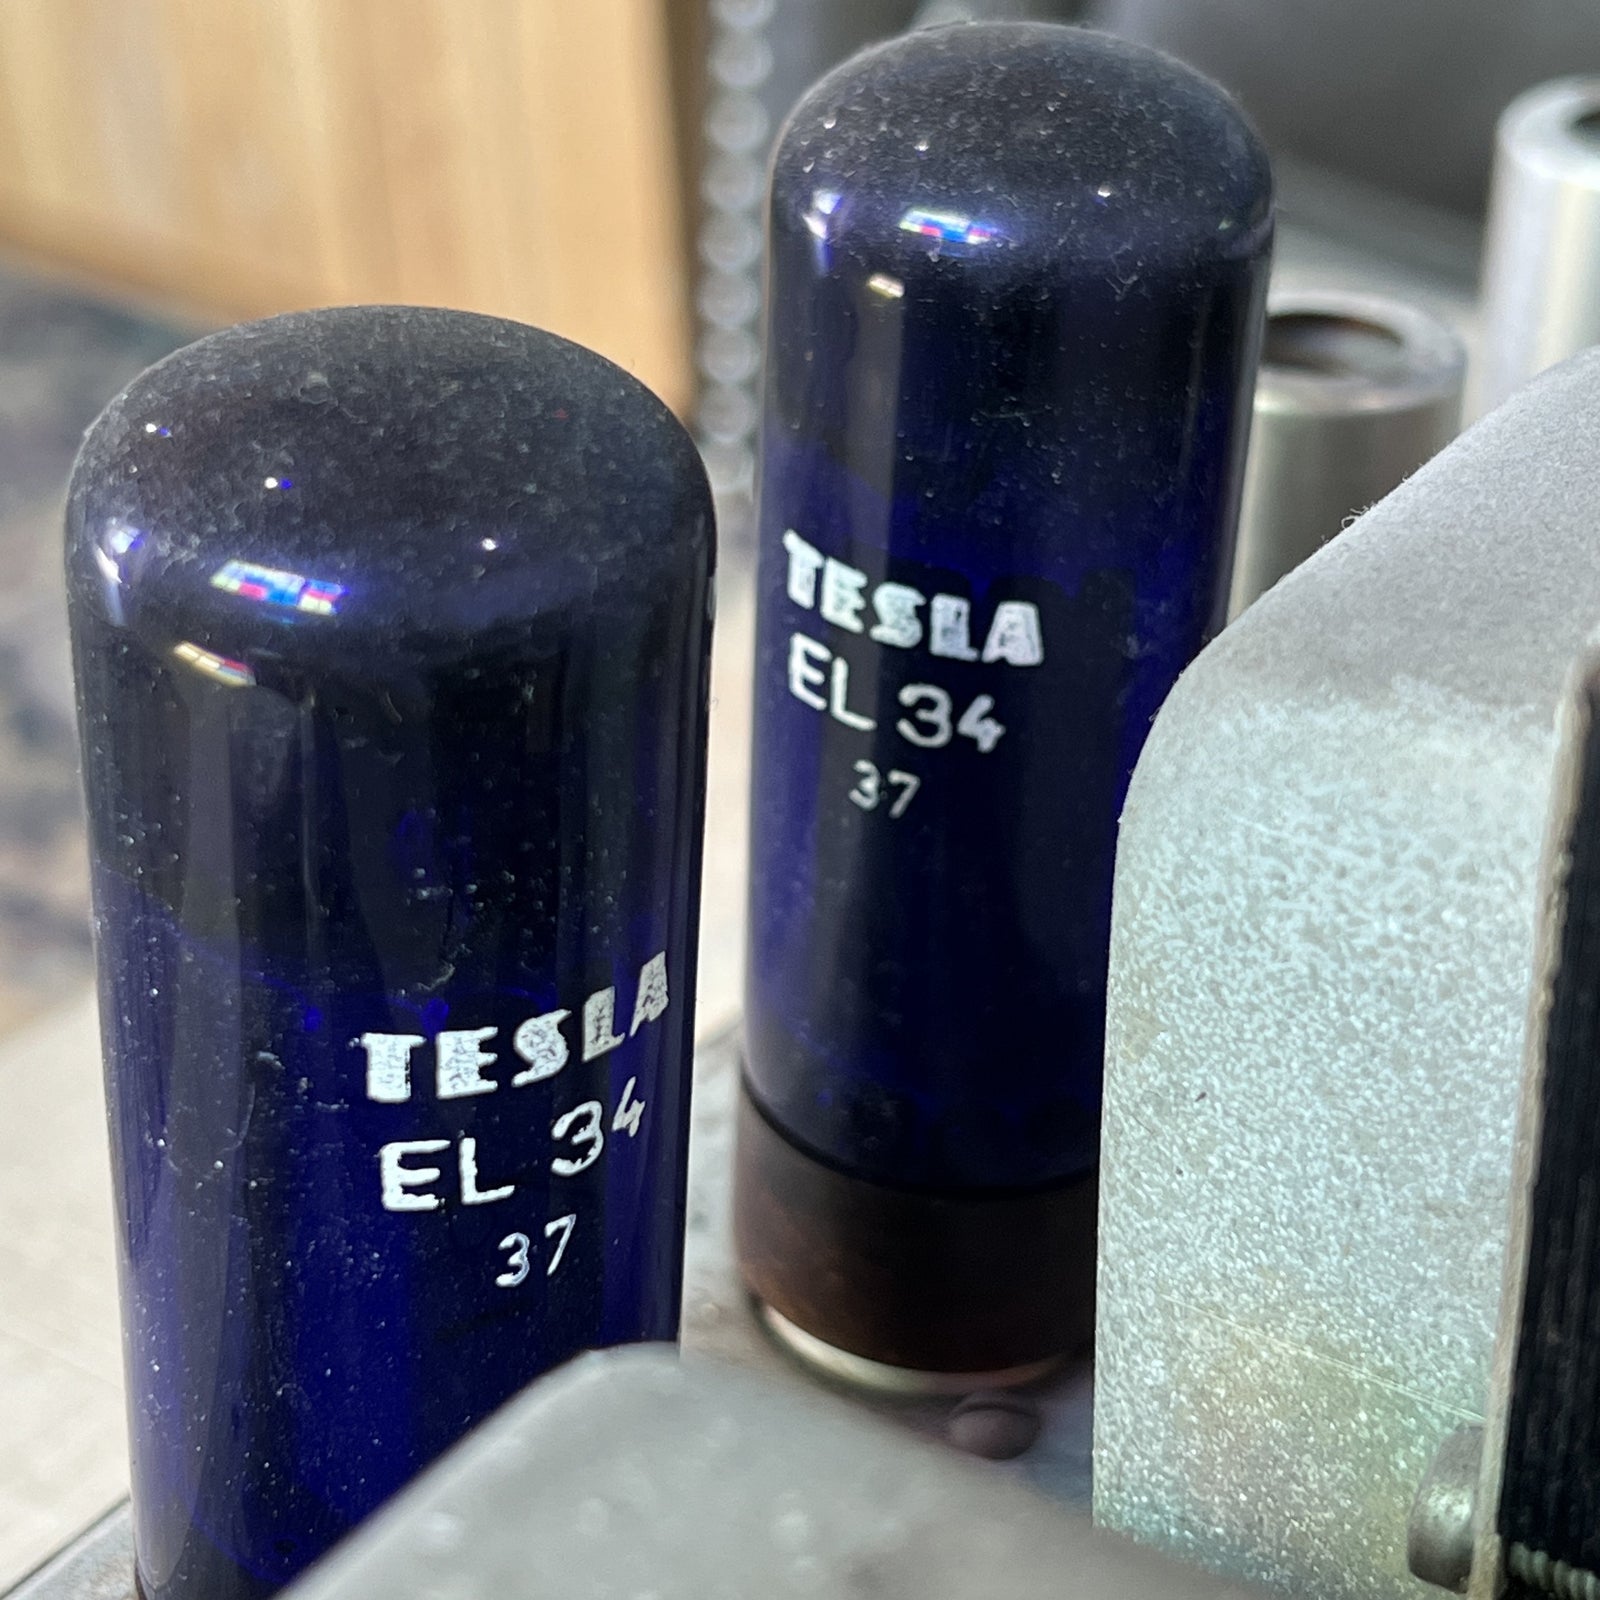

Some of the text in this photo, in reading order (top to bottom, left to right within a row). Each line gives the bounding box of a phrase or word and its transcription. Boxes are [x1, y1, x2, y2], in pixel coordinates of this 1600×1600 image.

[782, 528, 1044, 667] TESLA
[787, 632, 1006, 753] EL 34
[849, 759, 921, 818] 37
[360, 950, 669, 1103] TESLA
[379, 1076, 646, 1211] EL 34
[495, 1214, 577, 1287] 37
